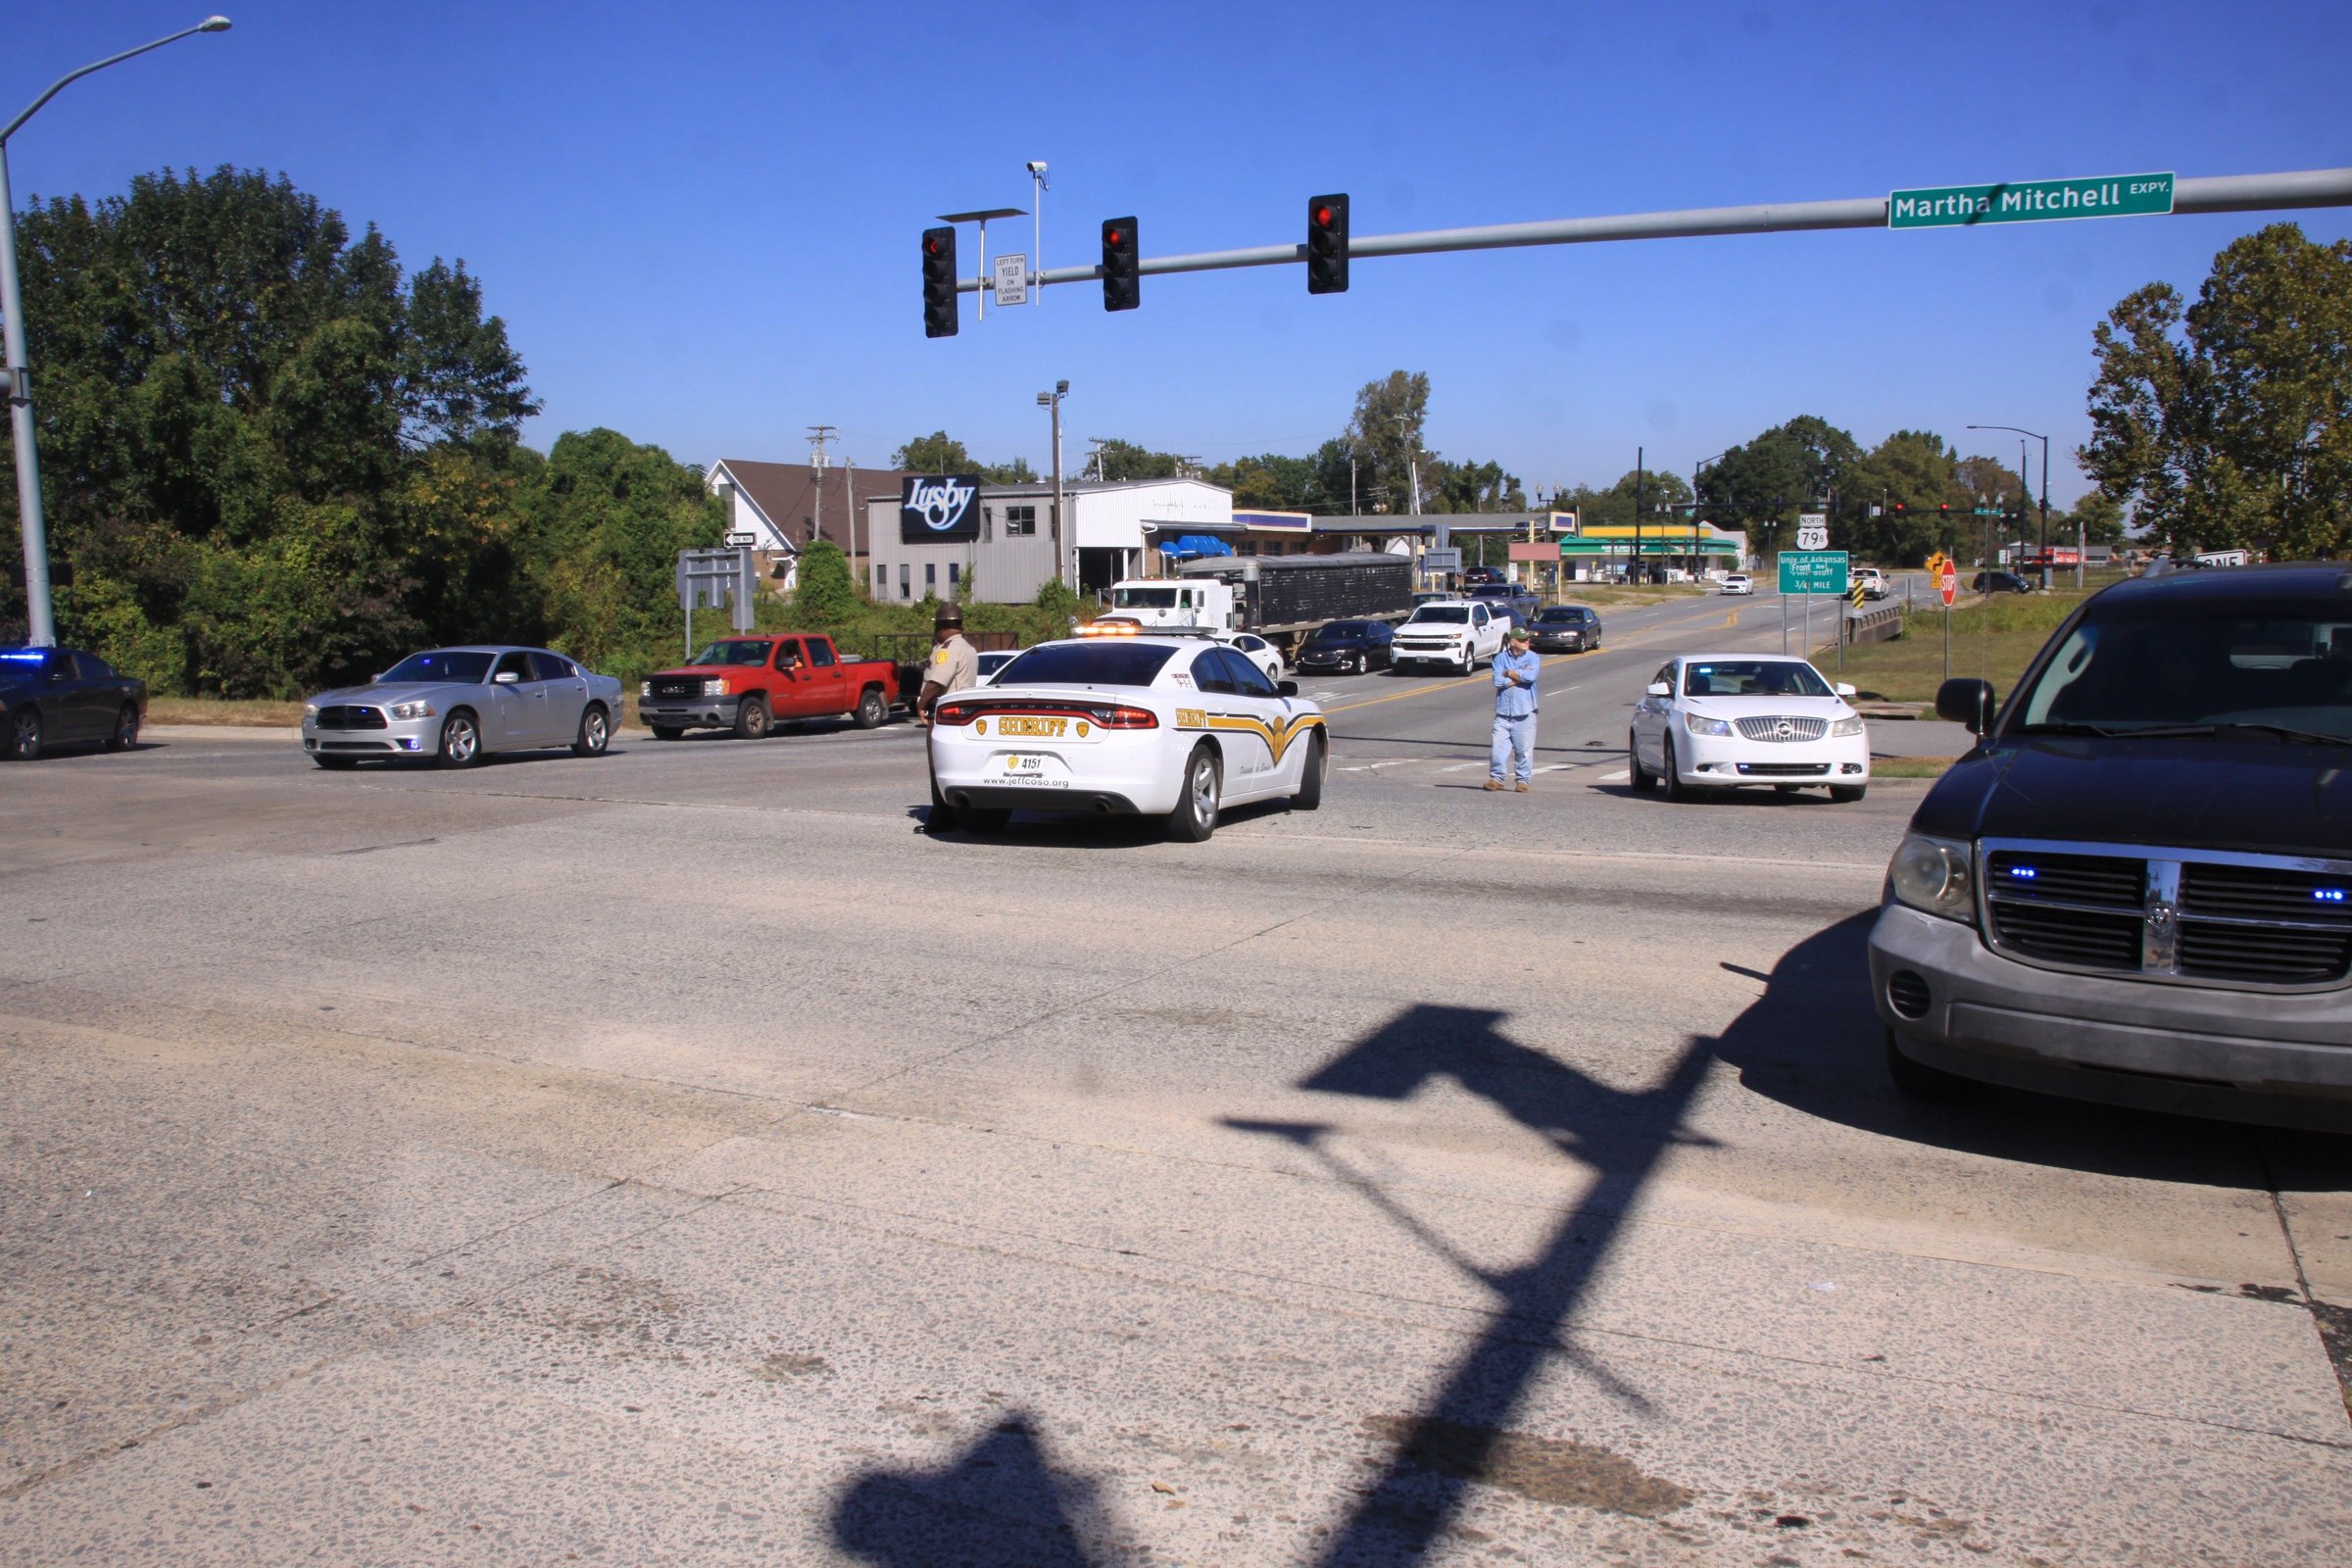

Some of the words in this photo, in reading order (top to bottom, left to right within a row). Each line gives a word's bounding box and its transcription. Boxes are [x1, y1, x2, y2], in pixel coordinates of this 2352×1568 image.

[1895, 194, 1990, 219] Martha
[2001, 184, 2120, 212] Mitchell
[2130, 181, 2170, 194] EXPY.
[1002, 267, 1019, 276] YIELD
[904, 478, 975, 530] Lusby
[1941, 574, 1955, 591] STOP
[999, 716, 1067, 737] SHERIFF
[1021, 759, 1041, 768] 4151
[983, 777, 1069, 788] www.jeffcoso.org
